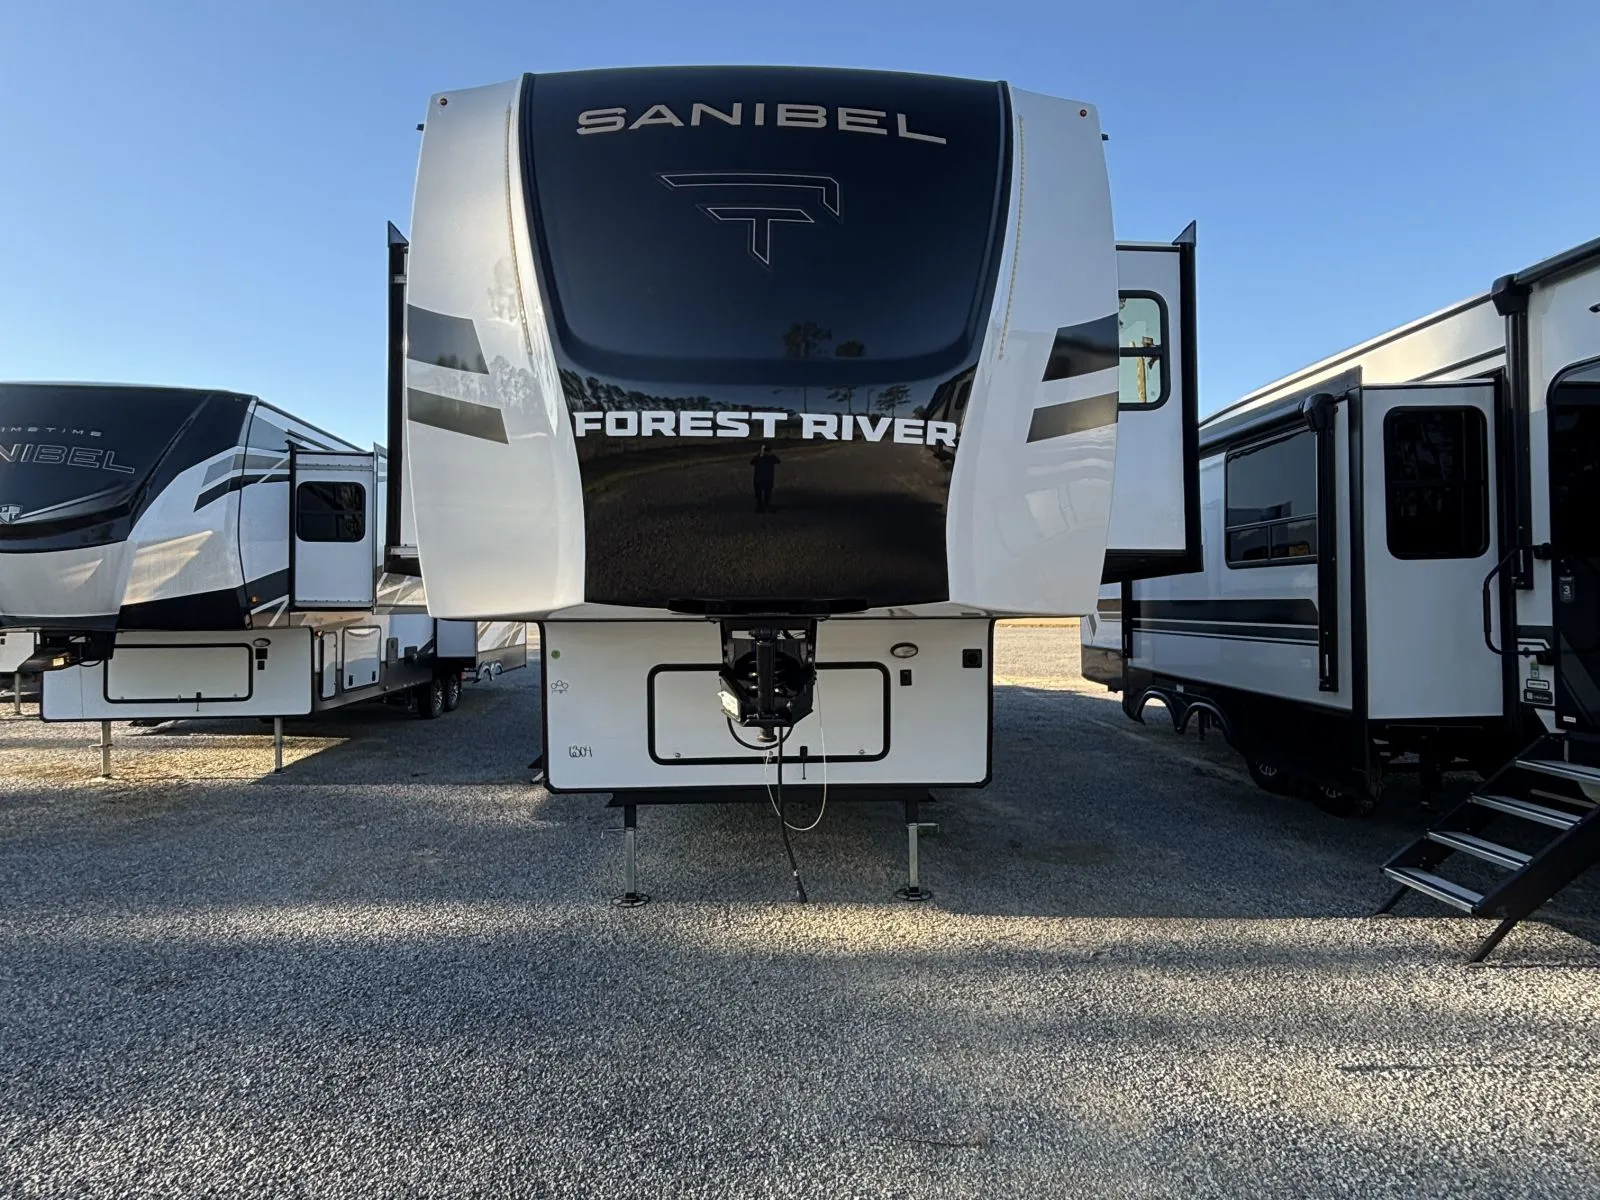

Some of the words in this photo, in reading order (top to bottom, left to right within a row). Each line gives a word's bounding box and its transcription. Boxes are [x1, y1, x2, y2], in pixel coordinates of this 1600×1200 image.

[576, 102, 947, 145] SANIBEL
[572, 410, 788, 438] FOREST
[800, 413, 957, 447] RIVER
